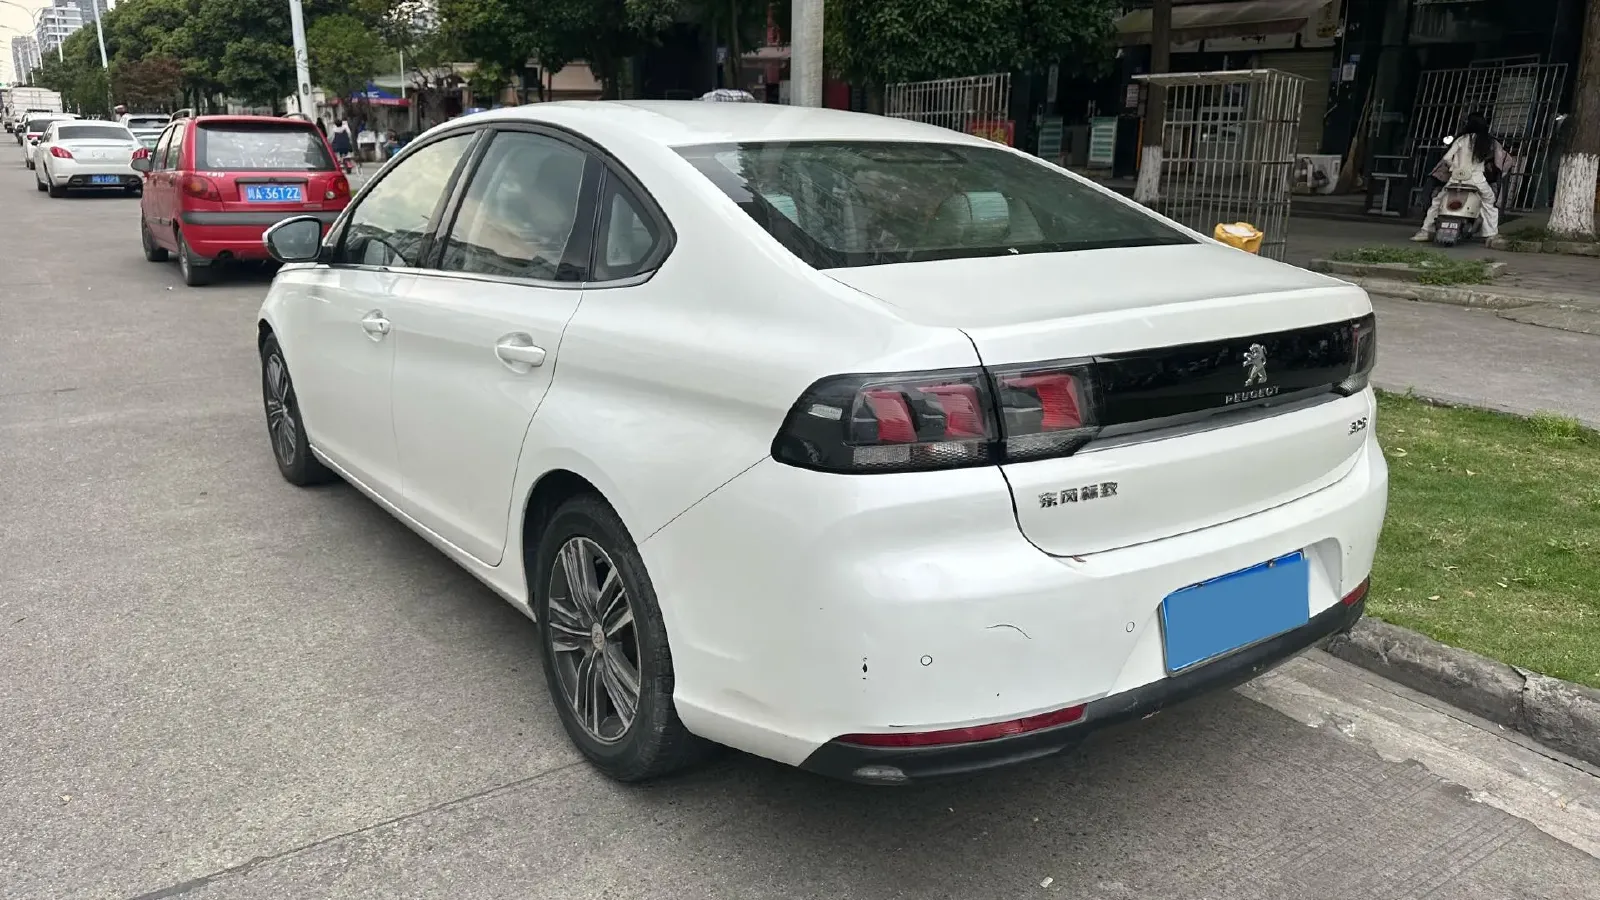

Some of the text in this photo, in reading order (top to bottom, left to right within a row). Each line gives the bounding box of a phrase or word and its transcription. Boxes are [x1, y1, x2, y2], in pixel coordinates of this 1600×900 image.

[1225, 385, 1280, 405] PEUGEOT
[1038, 481, 1118, 508] 东风标致
